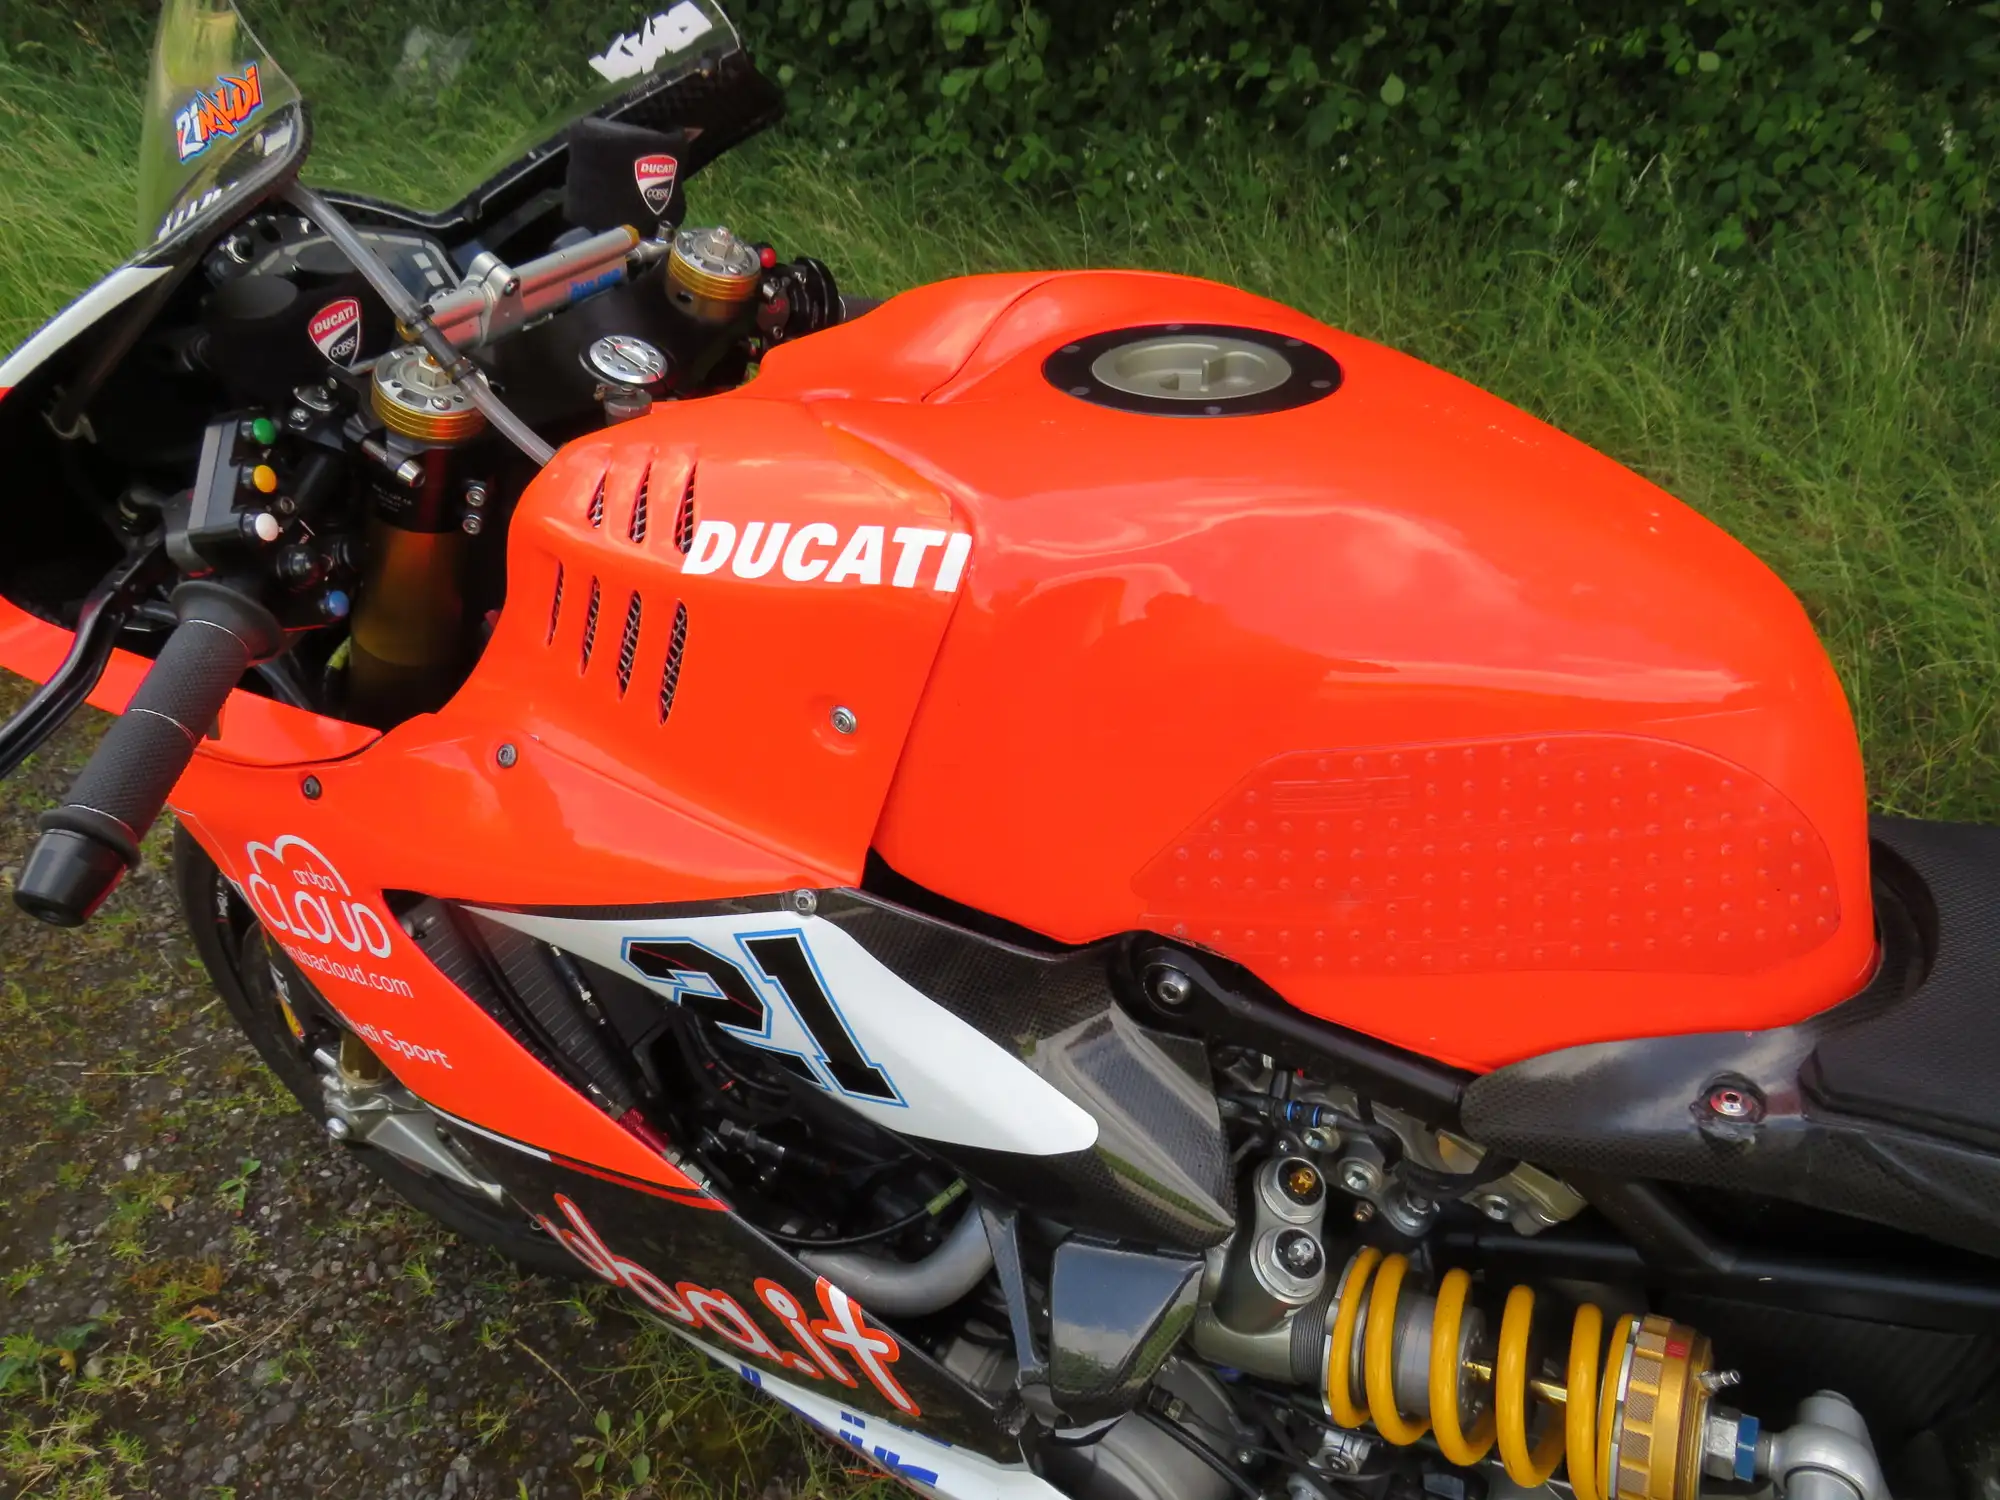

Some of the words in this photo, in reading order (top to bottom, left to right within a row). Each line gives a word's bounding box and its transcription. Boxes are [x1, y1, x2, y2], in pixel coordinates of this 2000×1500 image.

[640, 163, 674, 174] DUCATI
[313, 305, 354, 335] DUCATI
[330, 336, 356, 358] CORSE
[681, 520, 972, 593] DUCATI
[292, 860, 337, 892] aruba
[249, 873, 391, 959] CLOUD
[620, 928, 910, 1108] 21
[381, 1029, 453, 1069] Sport
